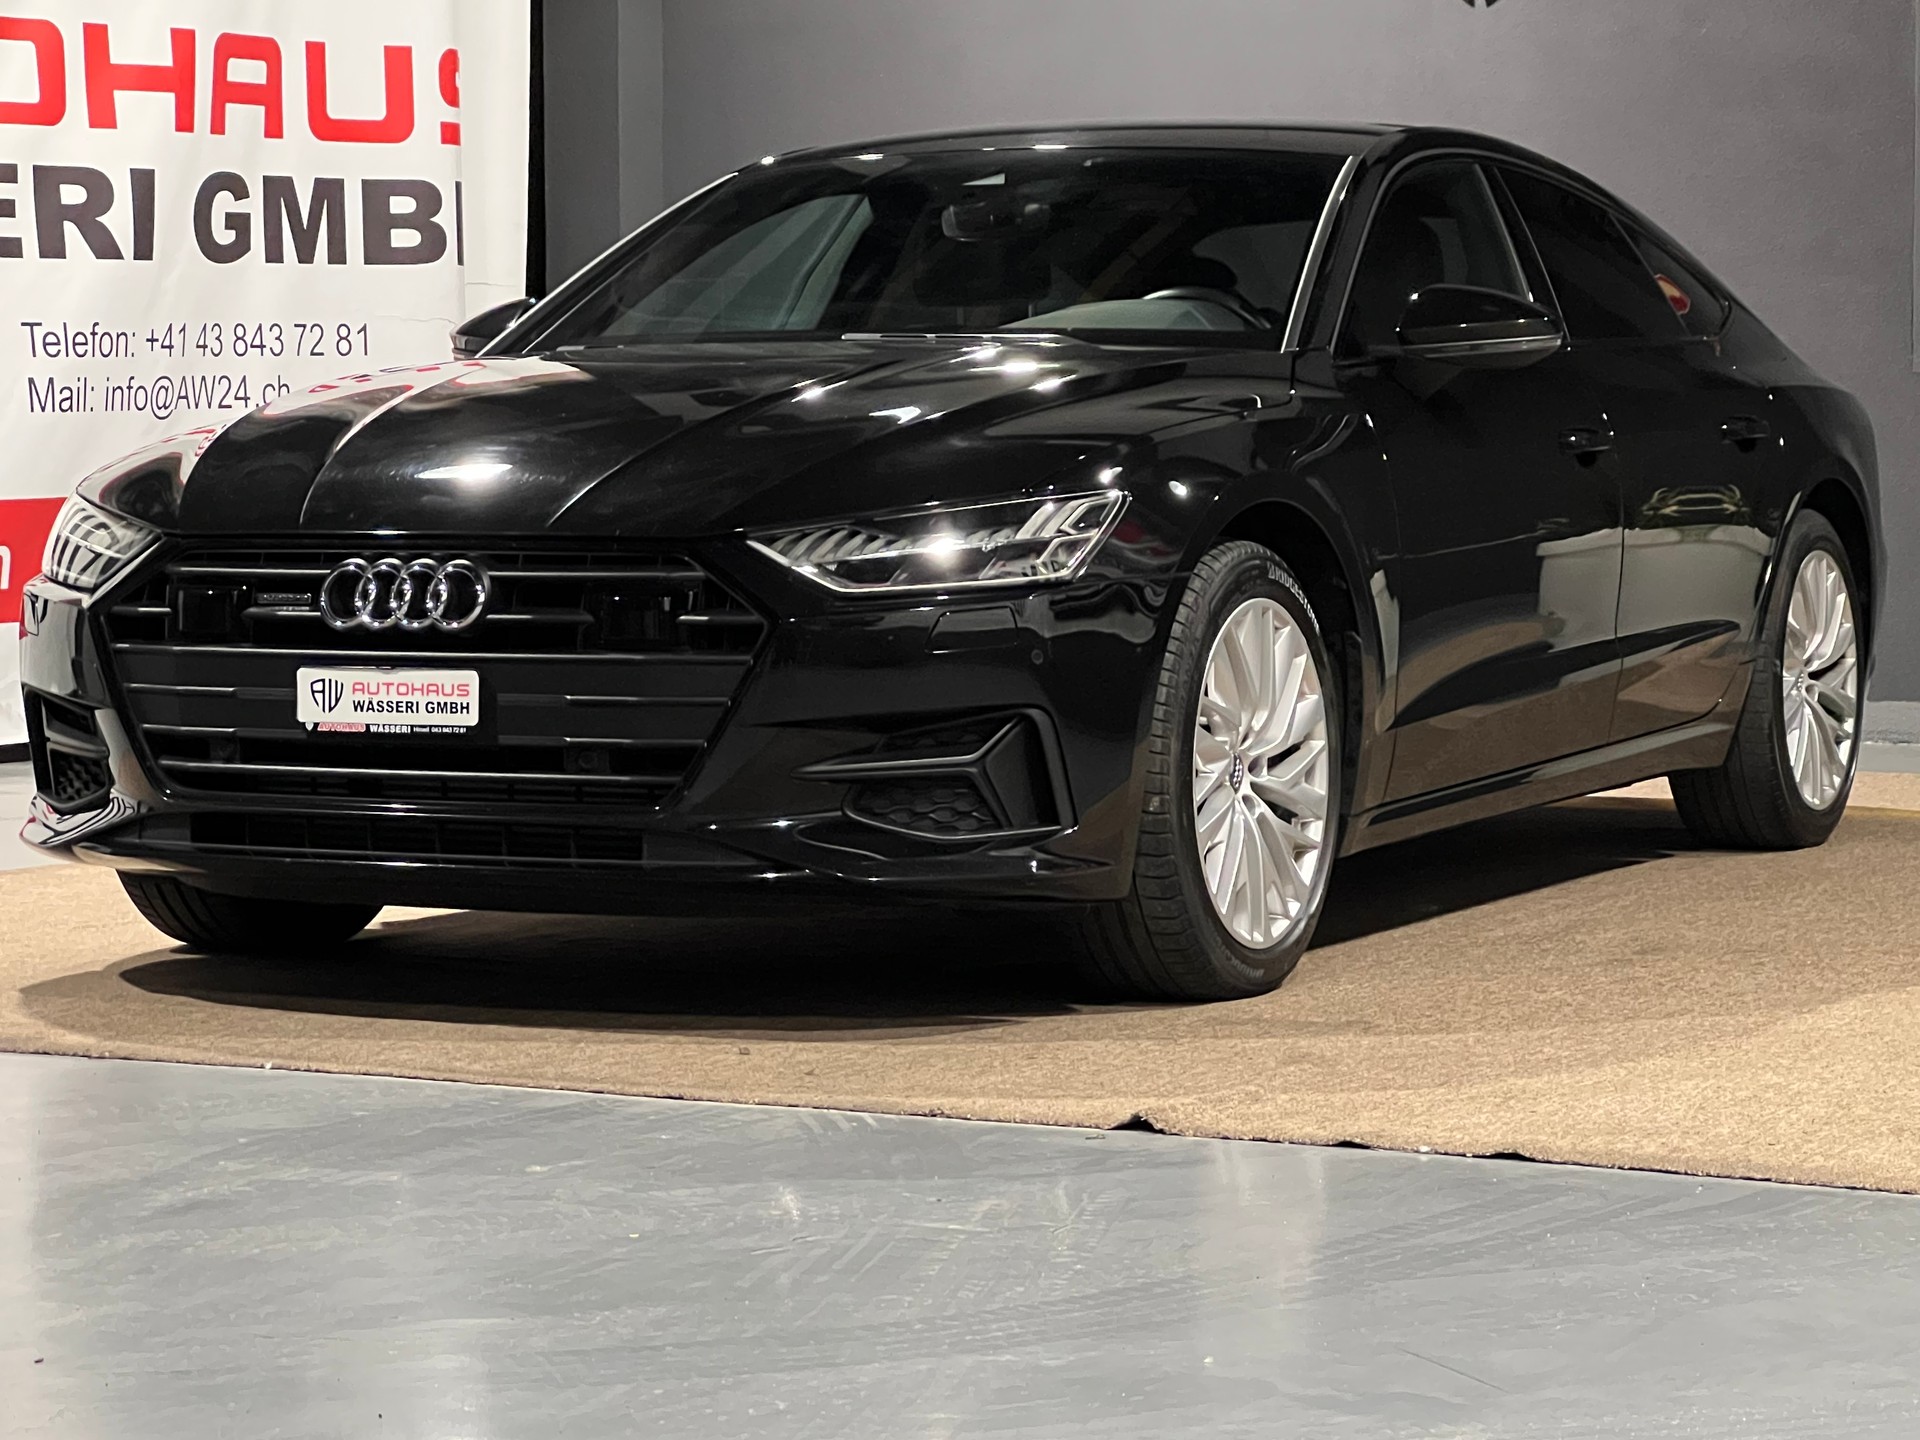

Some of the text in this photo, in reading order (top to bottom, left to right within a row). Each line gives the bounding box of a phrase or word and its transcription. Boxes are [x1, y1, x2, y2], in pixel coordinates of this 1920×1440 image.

[193, 171, 464, 266] GMB
[21, 322, 370, 359] Telefon: +41 43 843 72 81
[27, 376, 95, 414] Mail:
[1266, 560, 1320, 636] BRIDGESTONE
[352, 681, 470, 697] AUTOHAUS
[353, 698, 470, 715] WÄSSERI GMBH
